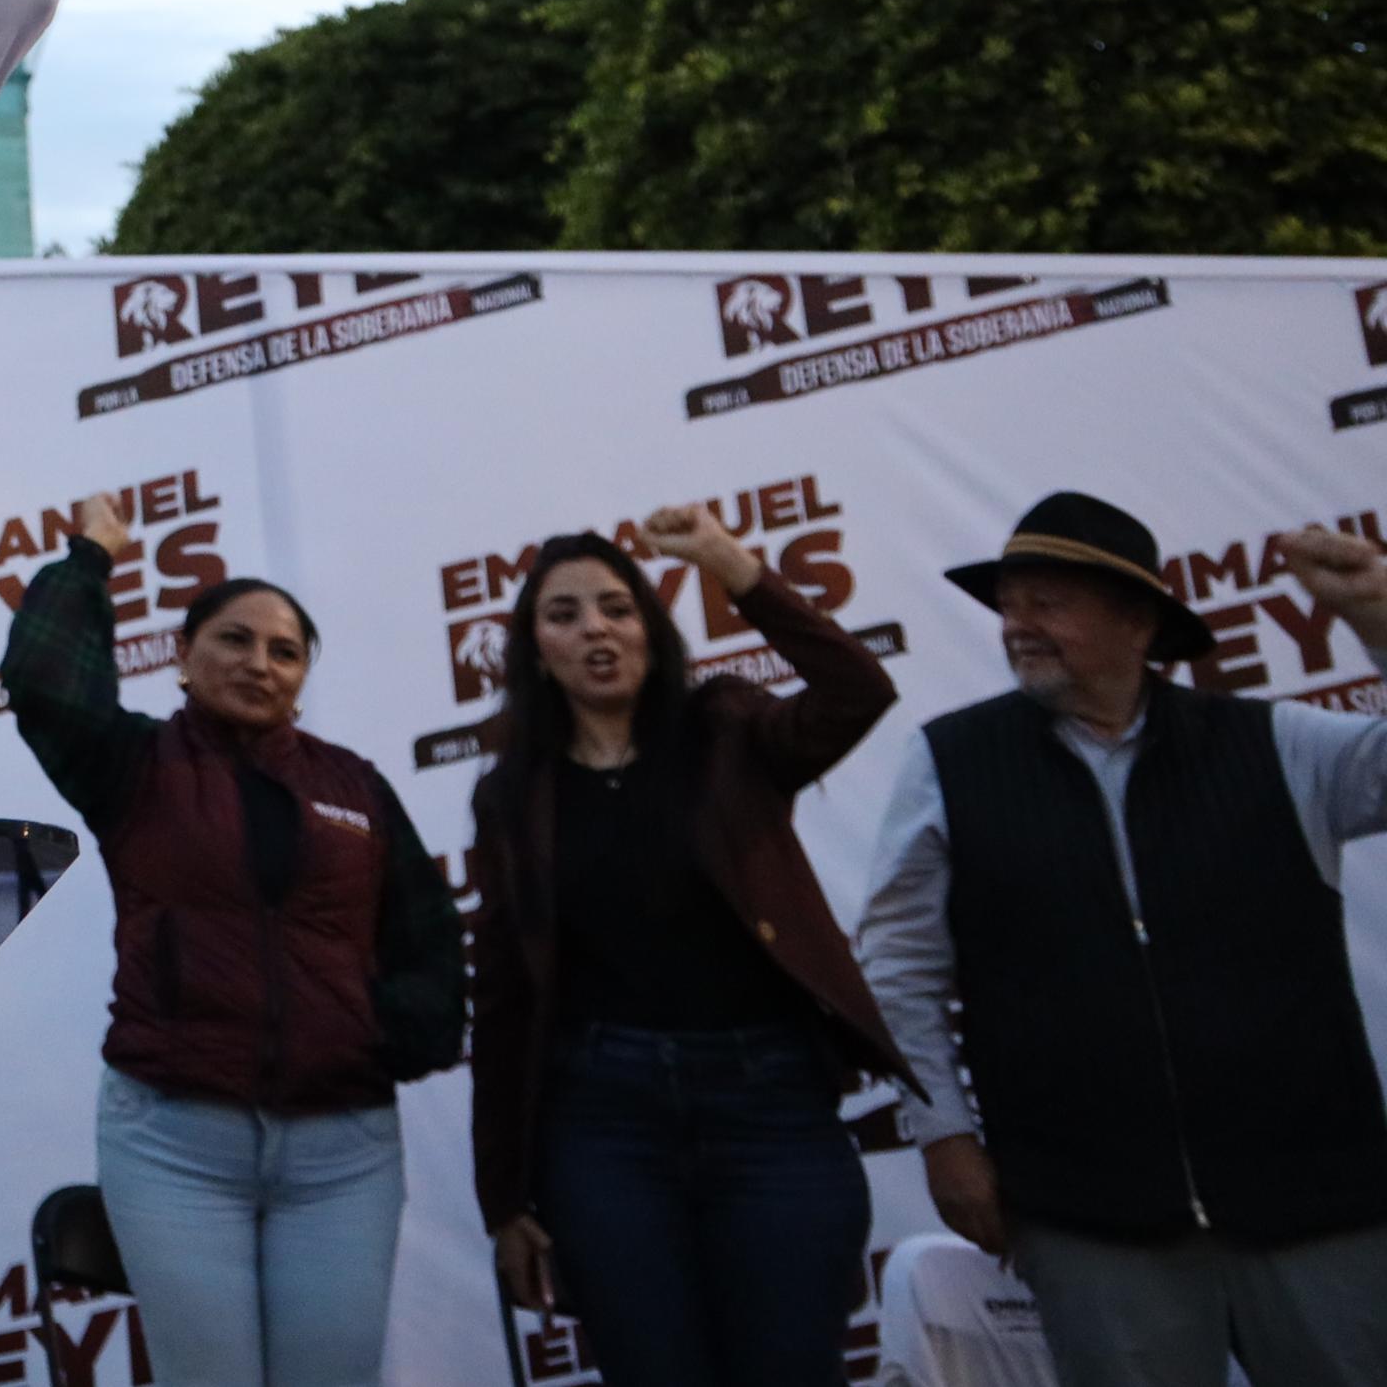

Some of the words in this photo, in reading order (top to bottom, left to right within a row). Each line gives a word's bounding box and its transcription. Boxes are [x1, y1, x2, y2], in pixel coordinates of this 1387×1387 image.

[170, 339, 268, 391] DEFENSA
[269, 332, 300, 364] DE
[301, 324, 330, 355] LA
[333, 294, 453, 349] SOBERANÍA
[779, 345, 879, 395] DEFENSA
[879, 336, 912, 367] DE
[914, 328, 947, 362] LA
[949, 297, 1075, 353] SOBERANÍA
